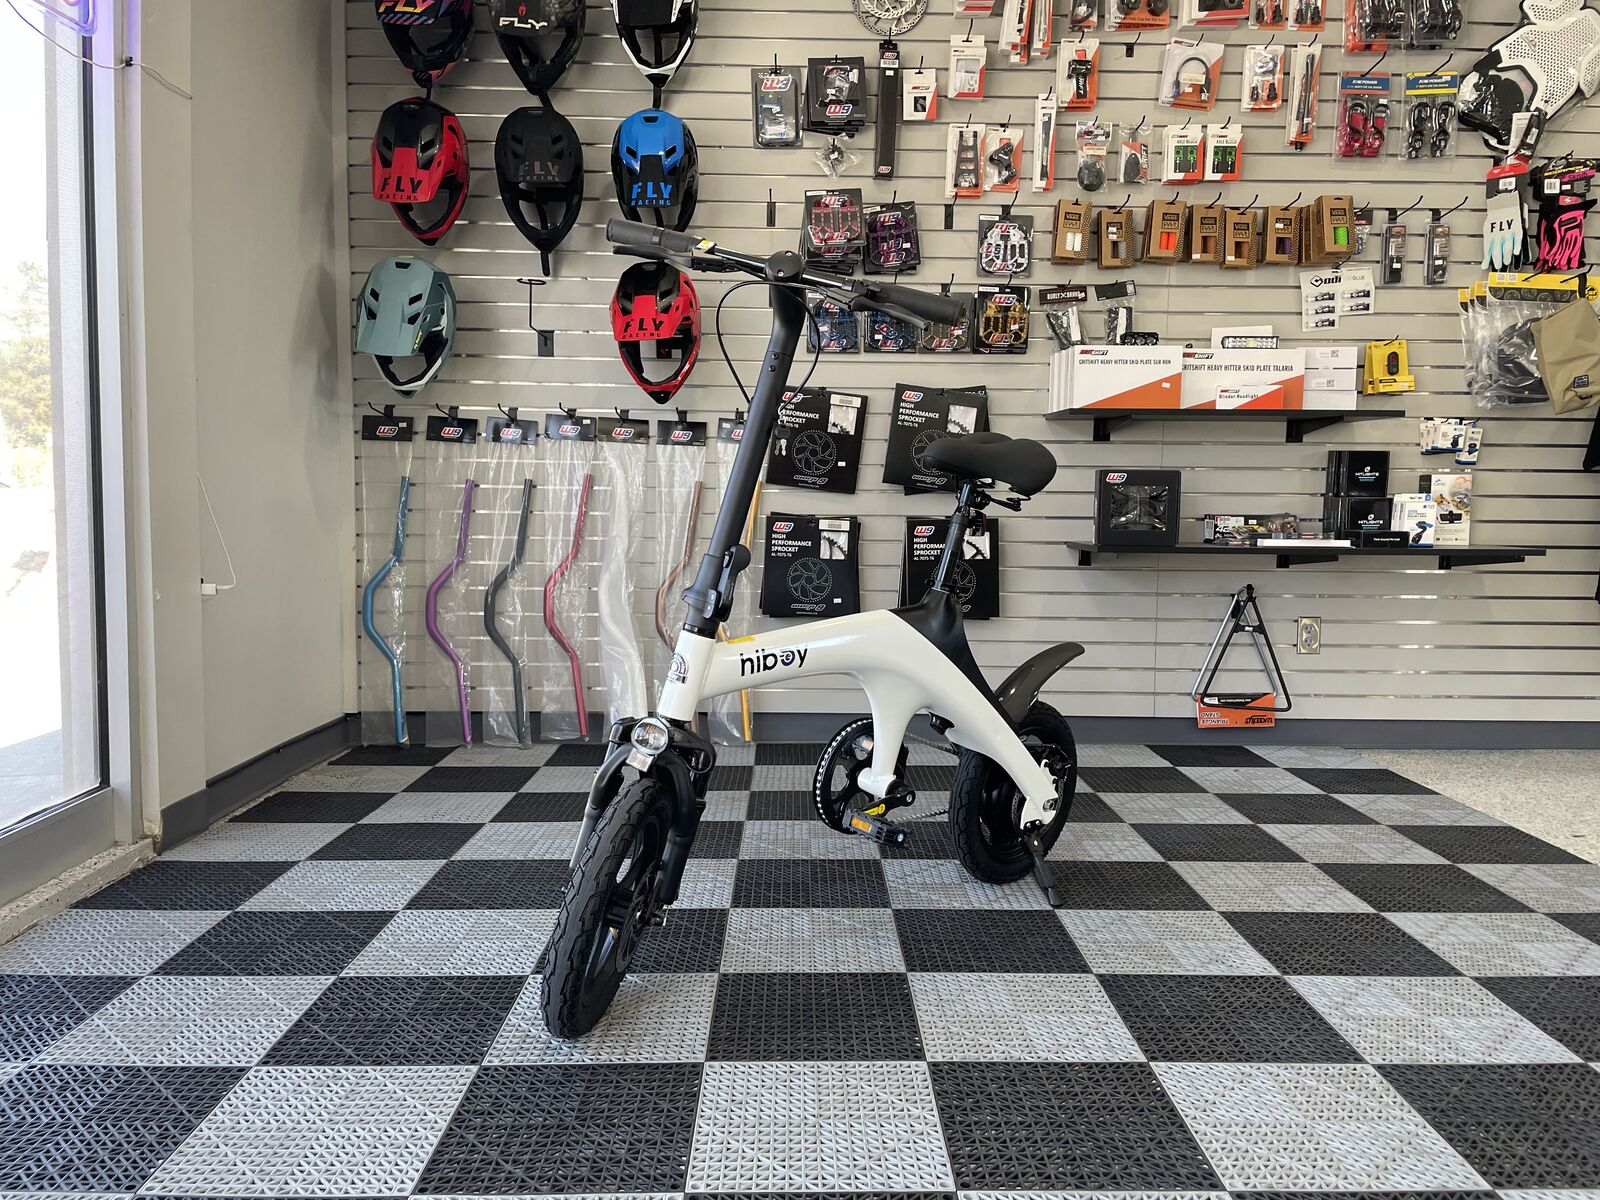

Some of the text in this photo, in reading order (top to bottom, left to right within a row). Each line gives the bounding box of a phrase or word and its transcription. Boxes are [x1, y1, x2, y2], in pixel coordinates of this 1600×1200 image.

[499, 17, 548, 30] FLY
[826, 104, 852, 116] W9
[519, 161, 560, 176] FLY
[381, 176, 423, 193] FLY
[631, 182, 673, 199] FLY
[1490, 219, 1514, 233] FLY
[624, 319, 664, 333] FLY
[622, 331, 661, 339] RACING
[902, 391, 923, 401] W9
[899, 408, 939, 418] PERFORMANCE
[898, 415, 926, 423] SPROCKET
[376, 426, 398, 436] W9
[441, 427, 463, 437] W9
[500, 428, 522, 438] W9
[559, 425, 580, 435] W9
[612, 427, 634, 437] W9
[732, 429, 743, 439] W
[671, 431, 692, 440] W9
[1106, 473, 1127, 483] W9
[773, 522, 794, 532] W9
[914, 526, 935, 535] W9
